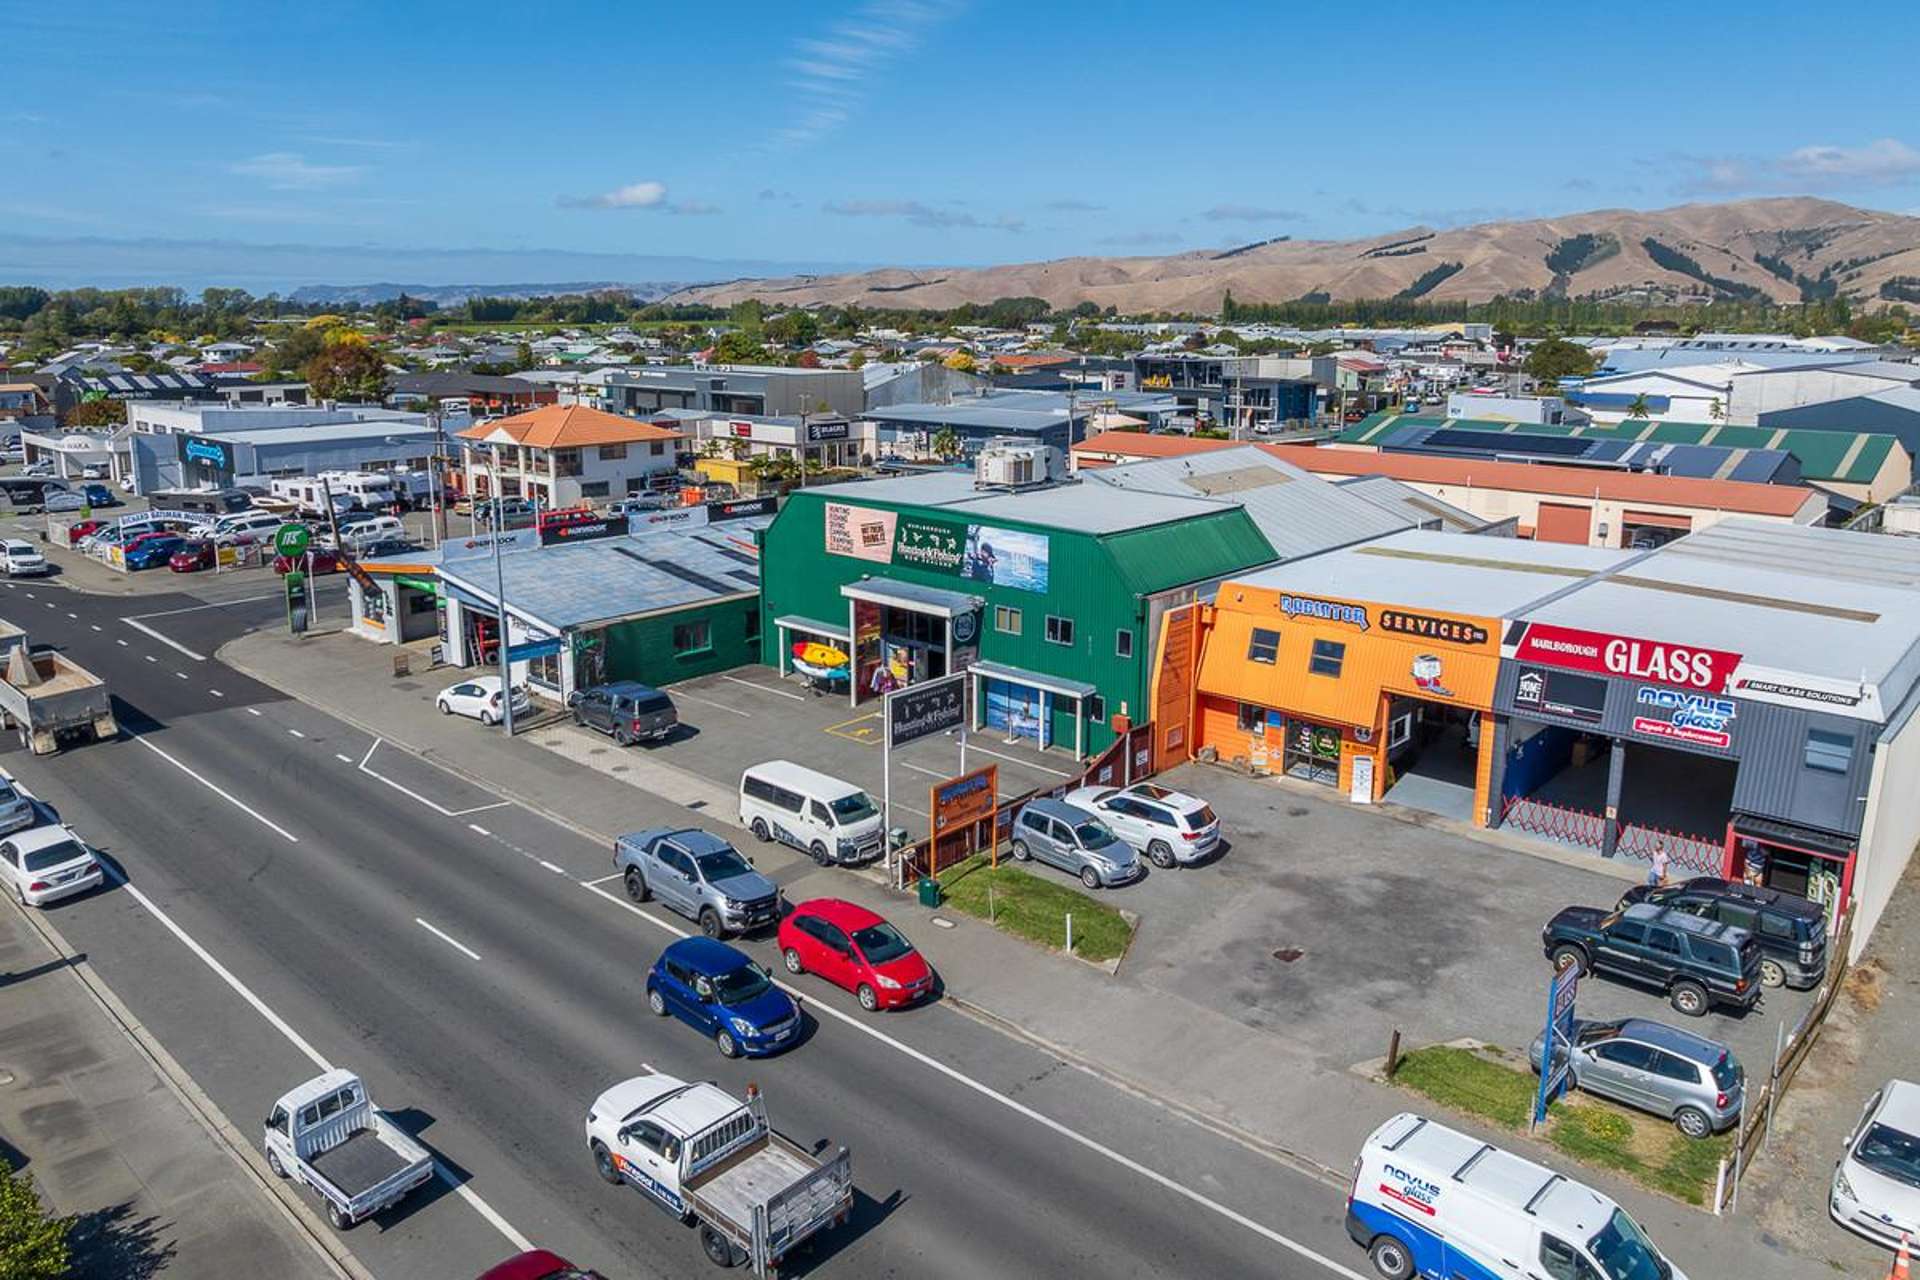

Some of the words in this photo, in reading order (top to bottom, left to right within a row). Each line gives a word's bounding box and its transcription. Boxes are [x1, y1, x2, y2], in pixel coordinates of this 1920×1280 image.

[1281, 595, 1370, 631] RADIATOR
[1382, 614, 1473, 641] SERVICES
[1530, 637, 1598, 658] MARLBOROUGH
[1604, 639, 1713, 687] GLASS
[1638, 687, 1736, 717] novus
[1750, 679, 1777, 692] SMART
[1778, 684, 1805, 696] GLASS
[1806, 690, 1853, 705] SOLUTIONS
[1639, 721, 1664, 733] Repair
[1664, 726, 1671, 734] &
[1673, 727, 1724, 743] Replacement
[1673, 710, 1722, 731] glass
[1383, 1163, 1441, 1198] novus
[1403, 1185, 1433, 1204] glass
